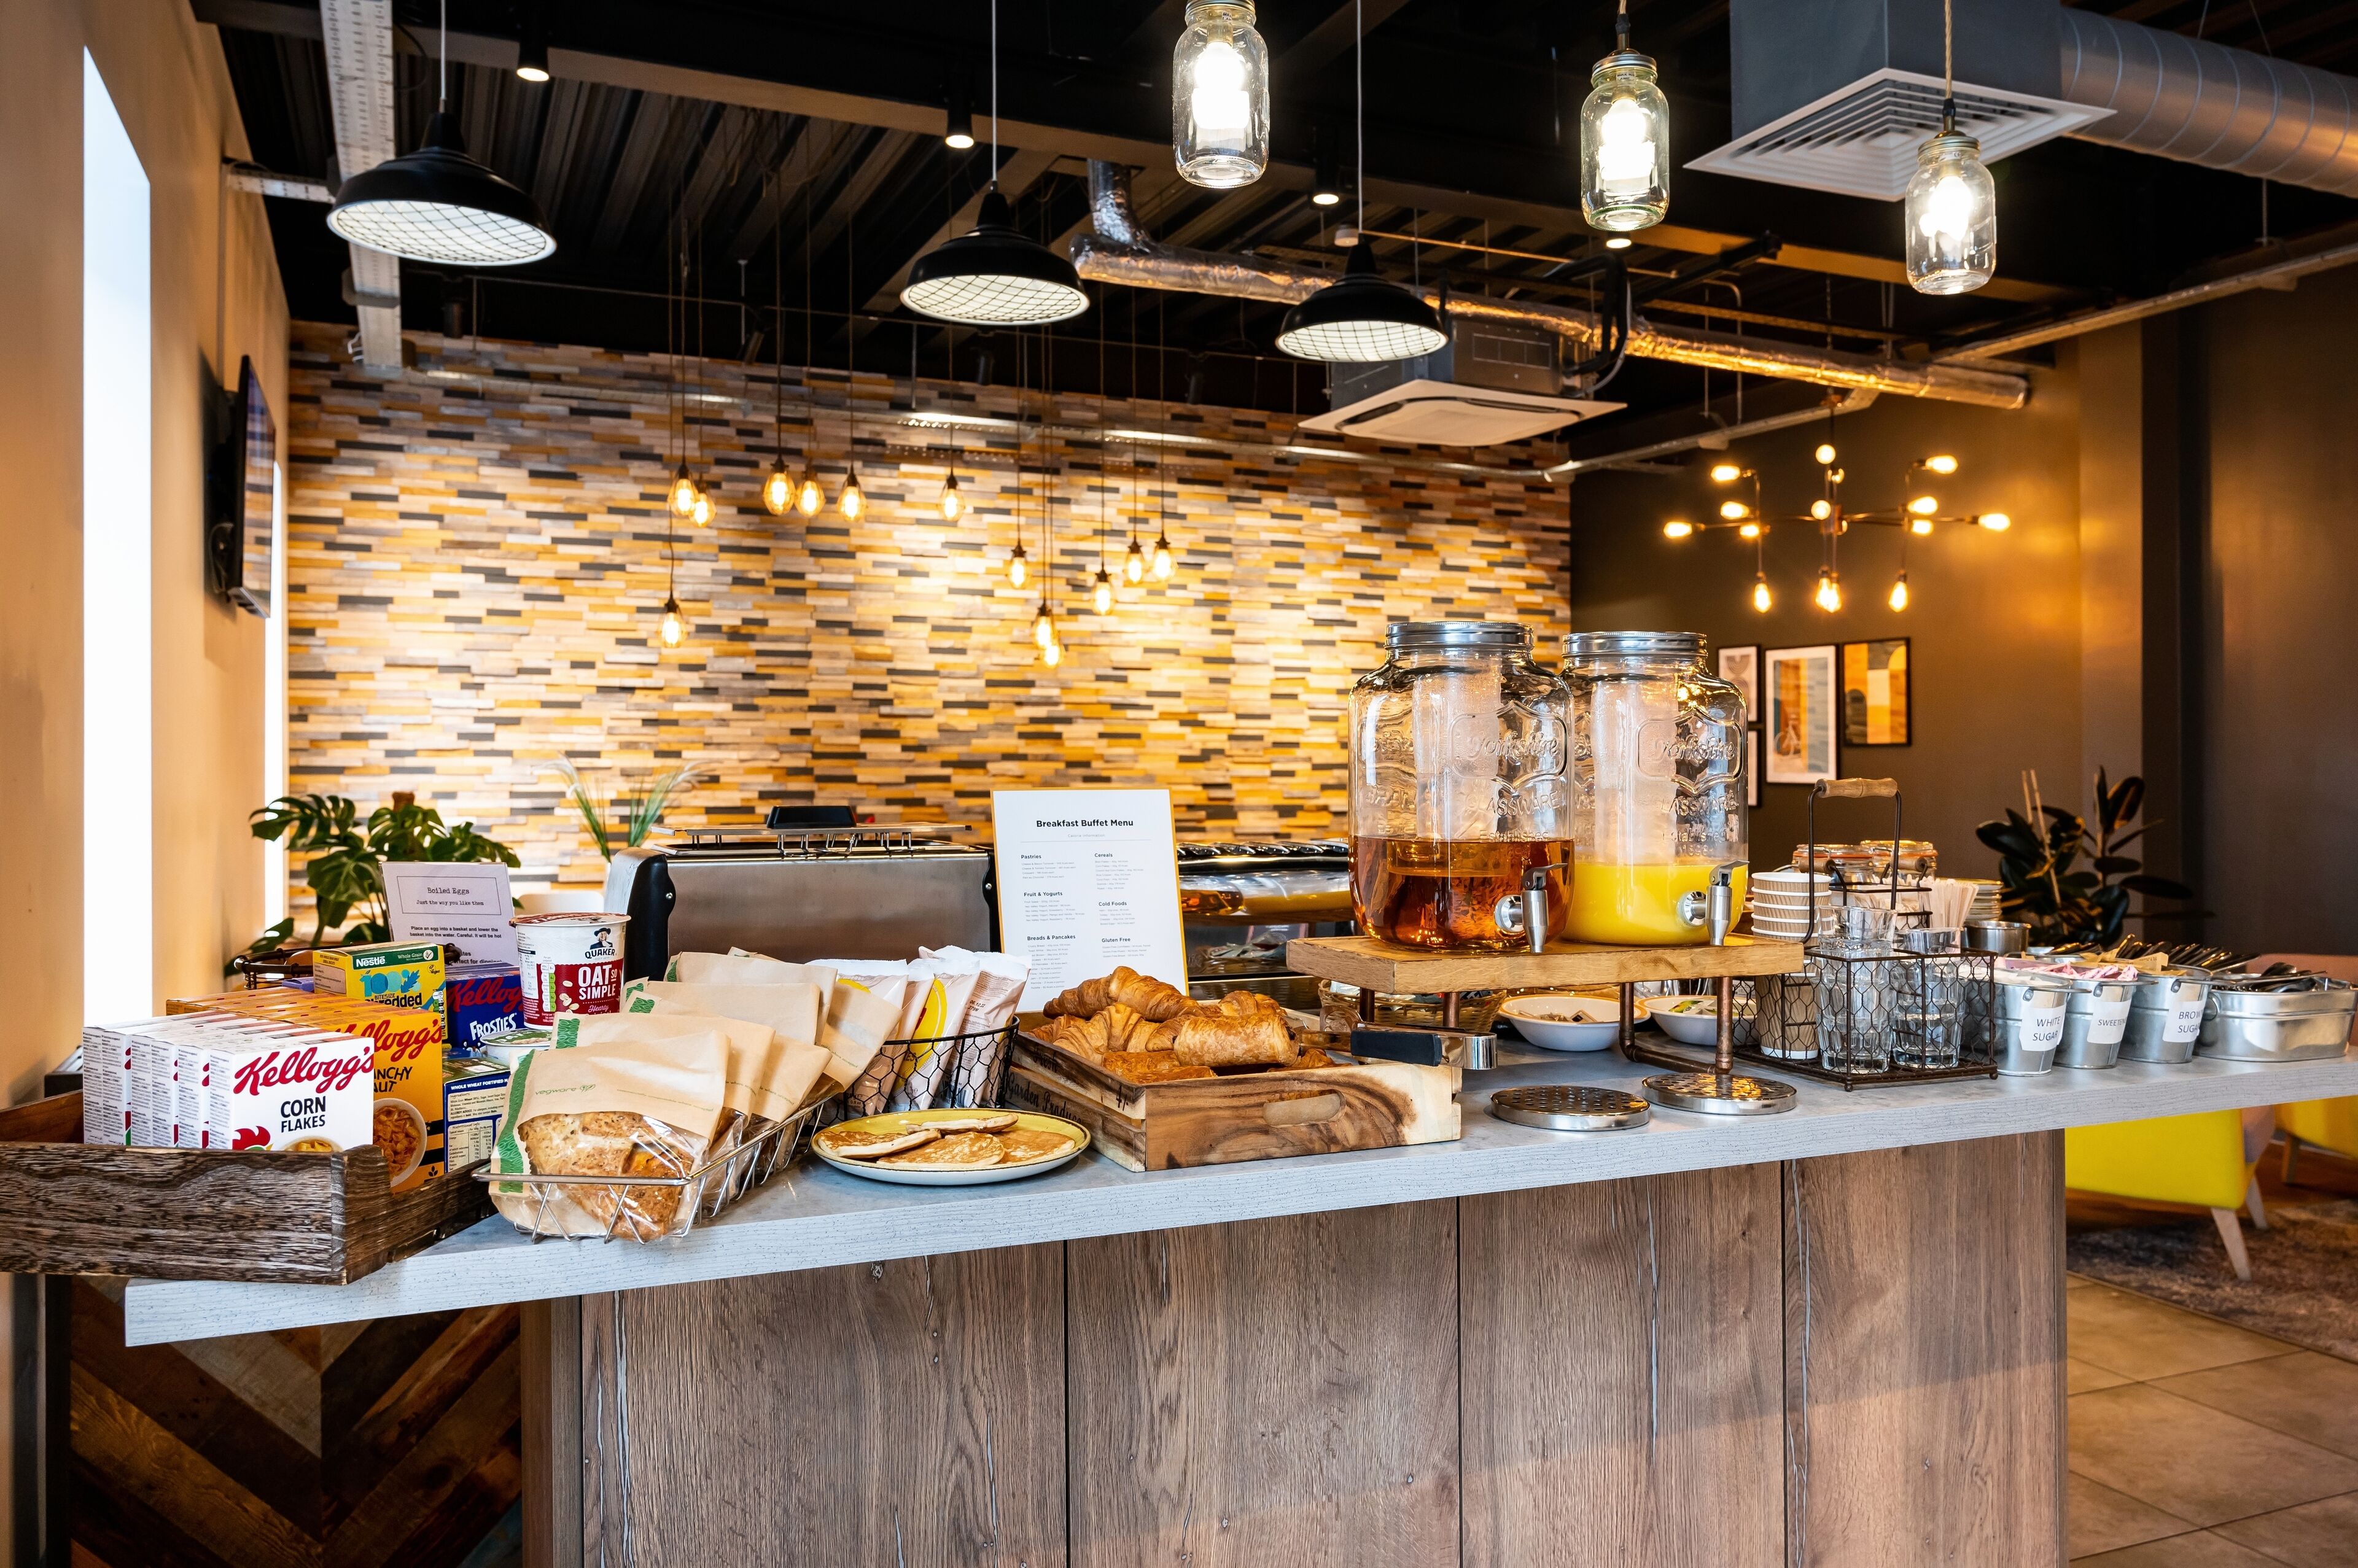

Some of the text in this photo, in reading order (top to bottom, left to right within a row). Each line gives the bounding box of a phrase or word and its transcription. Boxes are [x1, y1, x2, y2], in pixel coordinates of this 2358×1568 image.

[1660, 790, 1739, 816] LASSWARE
[585, 949, 615, 959] QUAKER
[578, 964, 618, 987] OAT SO
[446, 977, 523, 1013] Kellog
[579, 984, 617, 1000] SIMPLE
[588, 1004, 609, 1013] Hearty
[2179, 1009, 2203, 1020] BROW
[469, 1013, 516, 1041] FROSTIES
[2036, 1016, 2061, 1027] WHITE
[2177, 1022, 2200, 1033] SUGA
[2033, 1030, 2058, 1041] SUGAR
[831, 1050, 842, 1059] where
[233, 1046, 374, 1096] Kellogg's
[281, 1096, 326, 1118] CORN
[1008, 1073, 1081, 1124] Garden Produce
[281, 1114, 325, 1133] FLAKES
